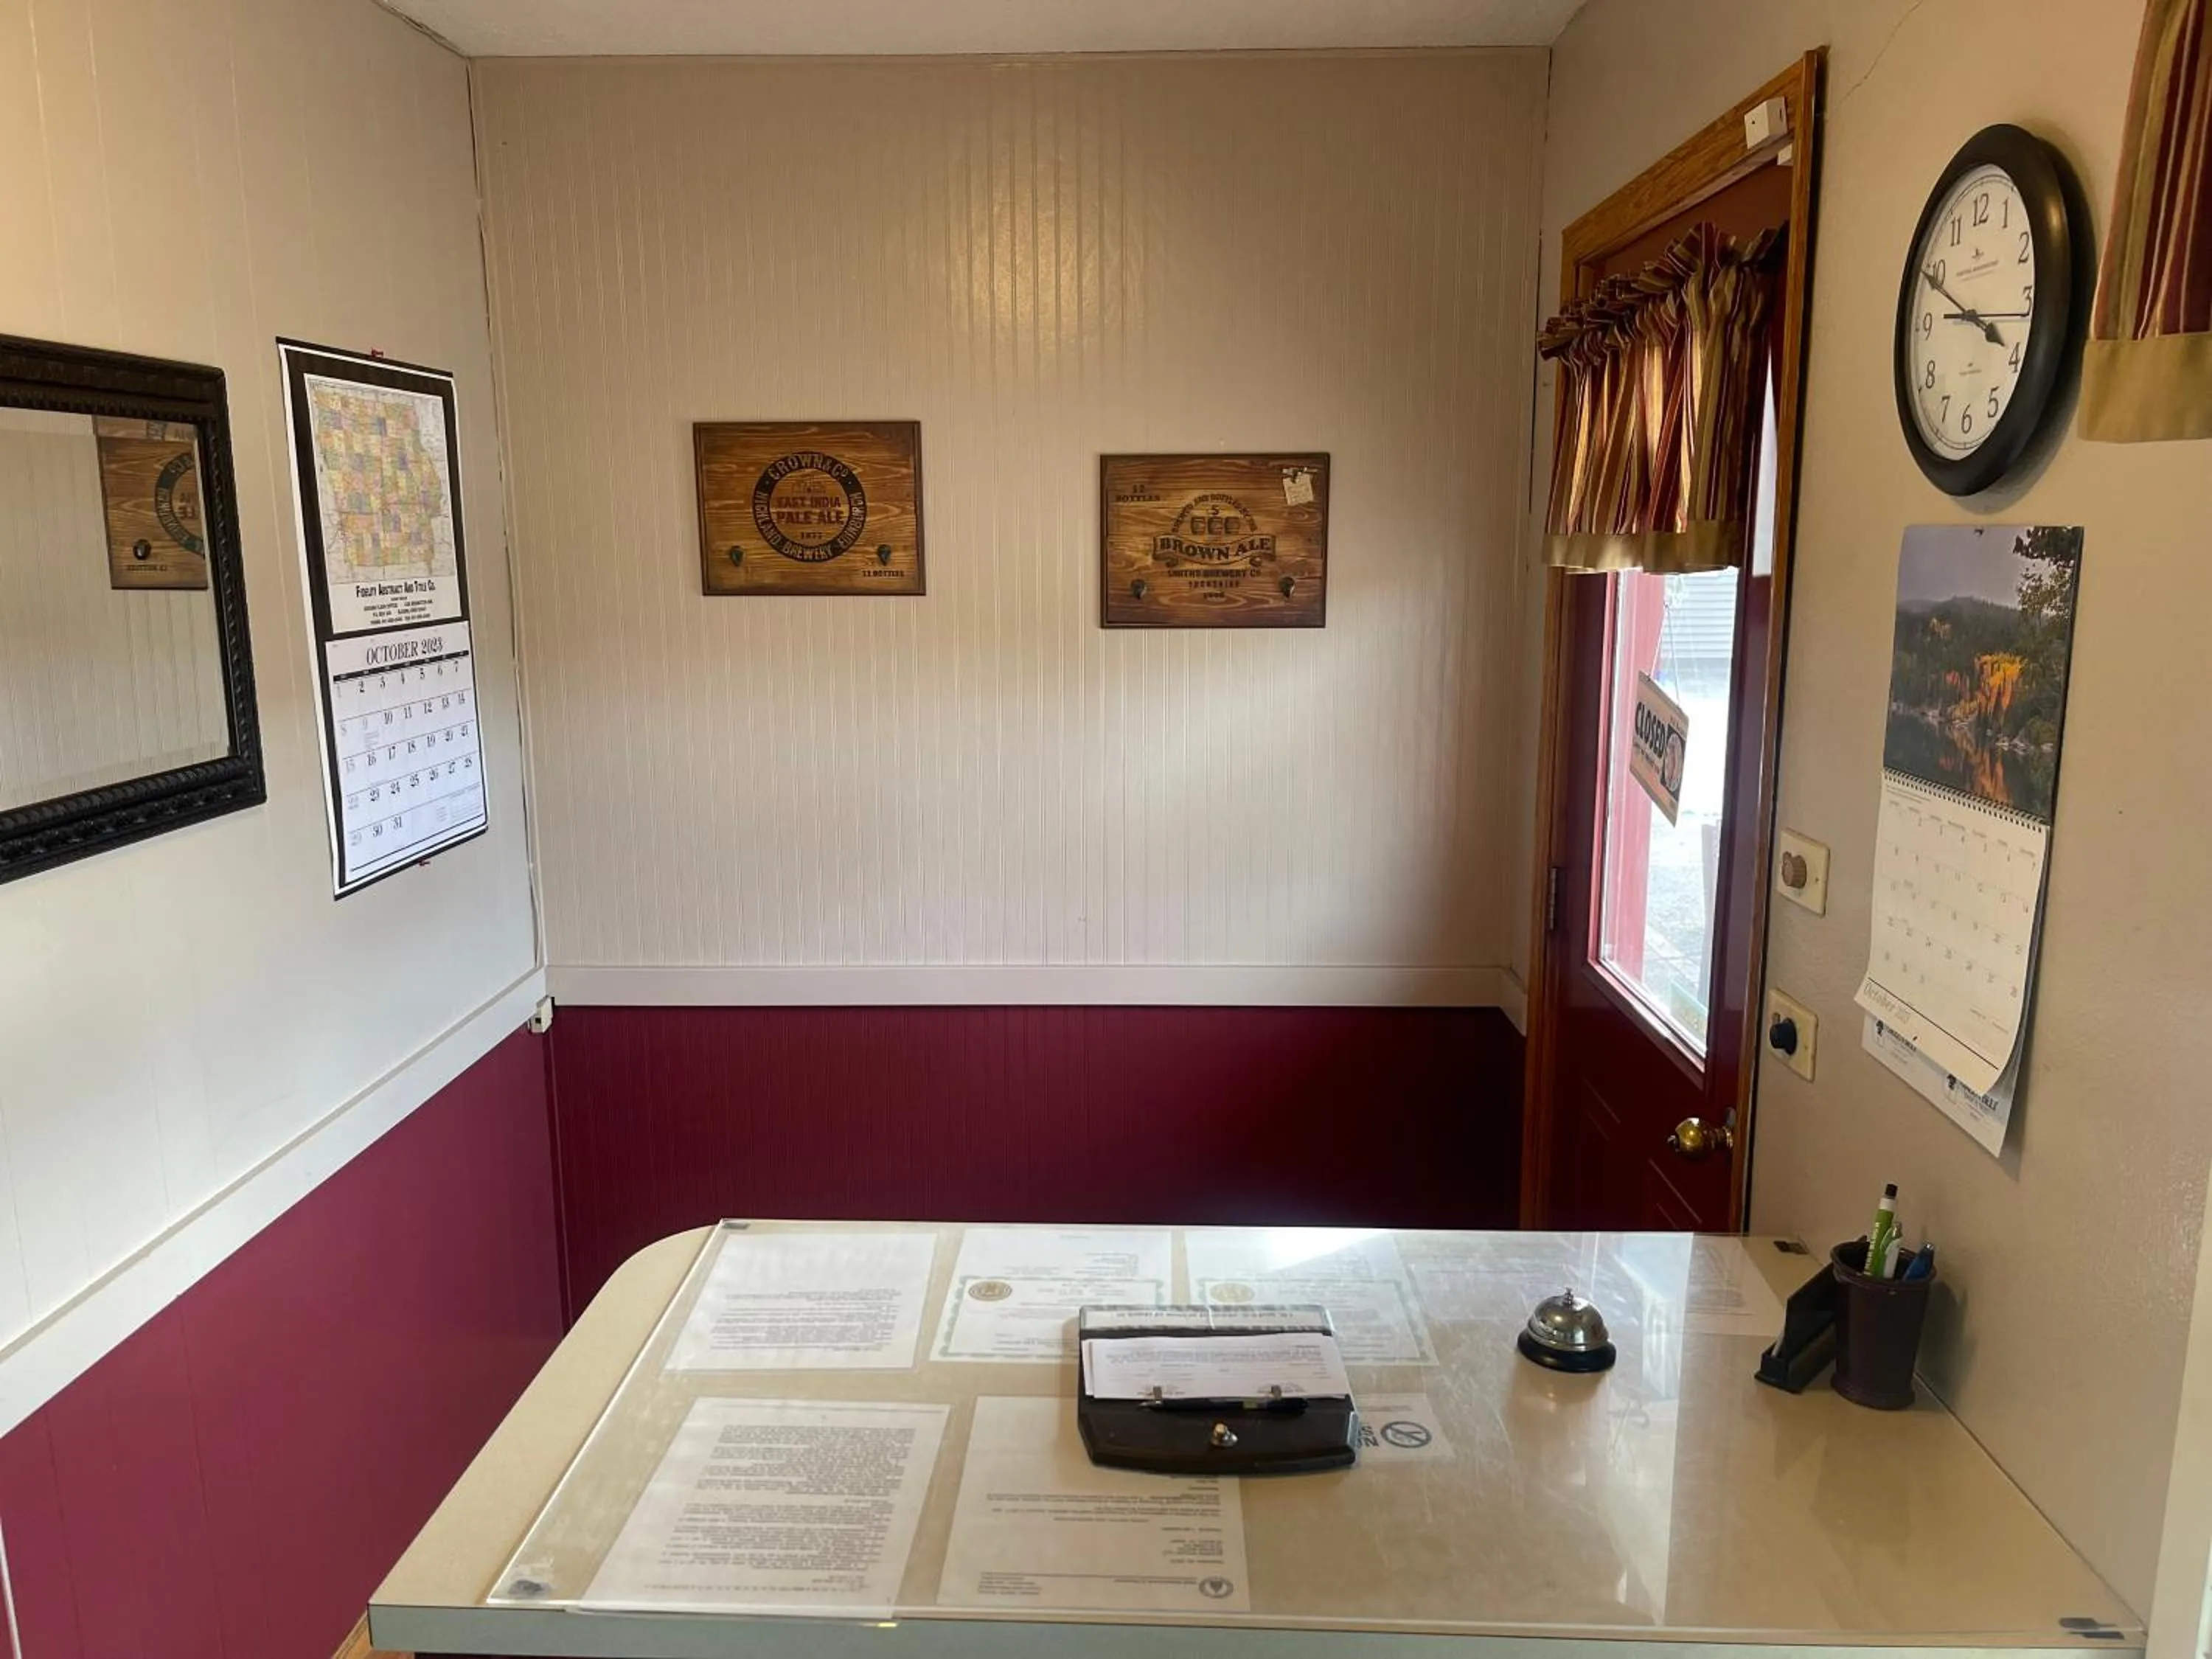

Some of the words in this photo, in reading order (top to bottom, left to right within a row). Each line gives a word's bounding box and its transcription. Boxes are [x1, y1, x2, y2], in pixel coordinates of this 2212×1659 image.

[1972, 193, 1989, 227] 12
[2001, 196, 2010, 229] 1
[1950, 214, 1962, 247] 11
[2017, 231, 2030, 265] 2
[1932, 259, 1946, 286] 10
[2022, 285, 2033, 317] 3
[1922, 312, 1933, 341] 9
[2008, 341, 2021, 374] 4
[1925, 360, 1935, 389] 8
[1941, 394, 1951, 422] 7
[1987, 386, 2000, 418] 5
[1961, 403, 1972, 434] 6
[810, 496, 841, 508] INDIA
[777, 511, 812, 524] PALE
[818, 510, 844, 524] ALE
[1160, 538, 1230, 561] BROWN
[1235, 538, 1270, 556] ALE
[1203, 569, 1246, 577] BREWERY
[366, 640, 418, 665] OCTOBER
[383, 712, 393, 725] 10
[403, 706, 412, 719] 11
[424, 701, 433, 714] 12
[1635, 701, 1666, 759] CLOSED
[388, 745, 396, 760] 17
[407, 742, 416, 754] 18
[427, 735, 436, 748] 19
[390, 782, 400, 795] 24
